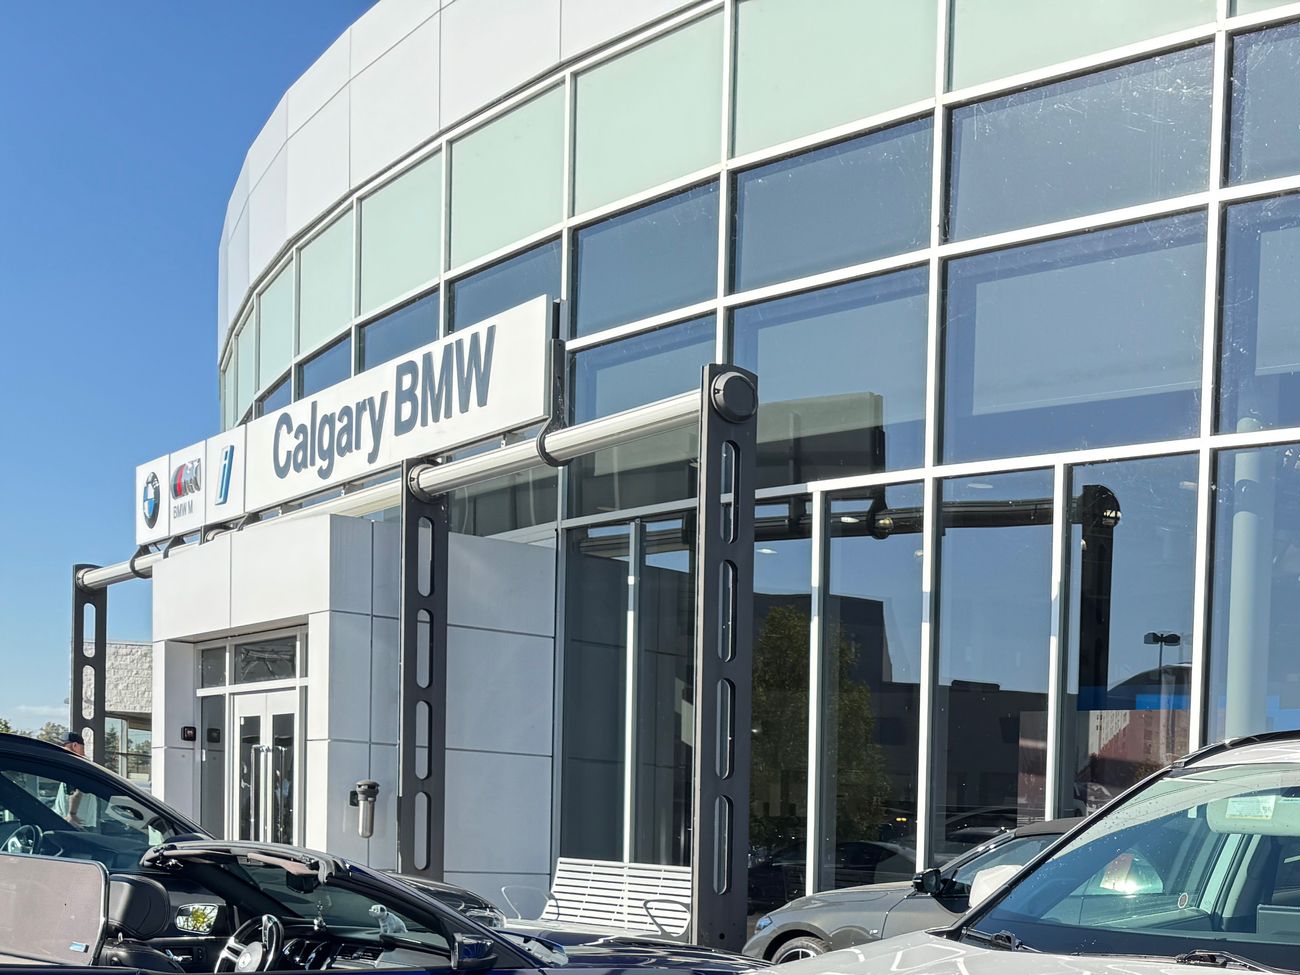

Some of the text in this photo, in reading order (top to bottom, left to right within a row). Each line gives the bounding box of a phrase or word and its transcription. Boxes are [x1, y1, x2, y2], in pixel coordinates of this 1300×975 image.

[273, 325, 496, 480] Calgary BMW
[173, 500, 194, 519] BMW M
